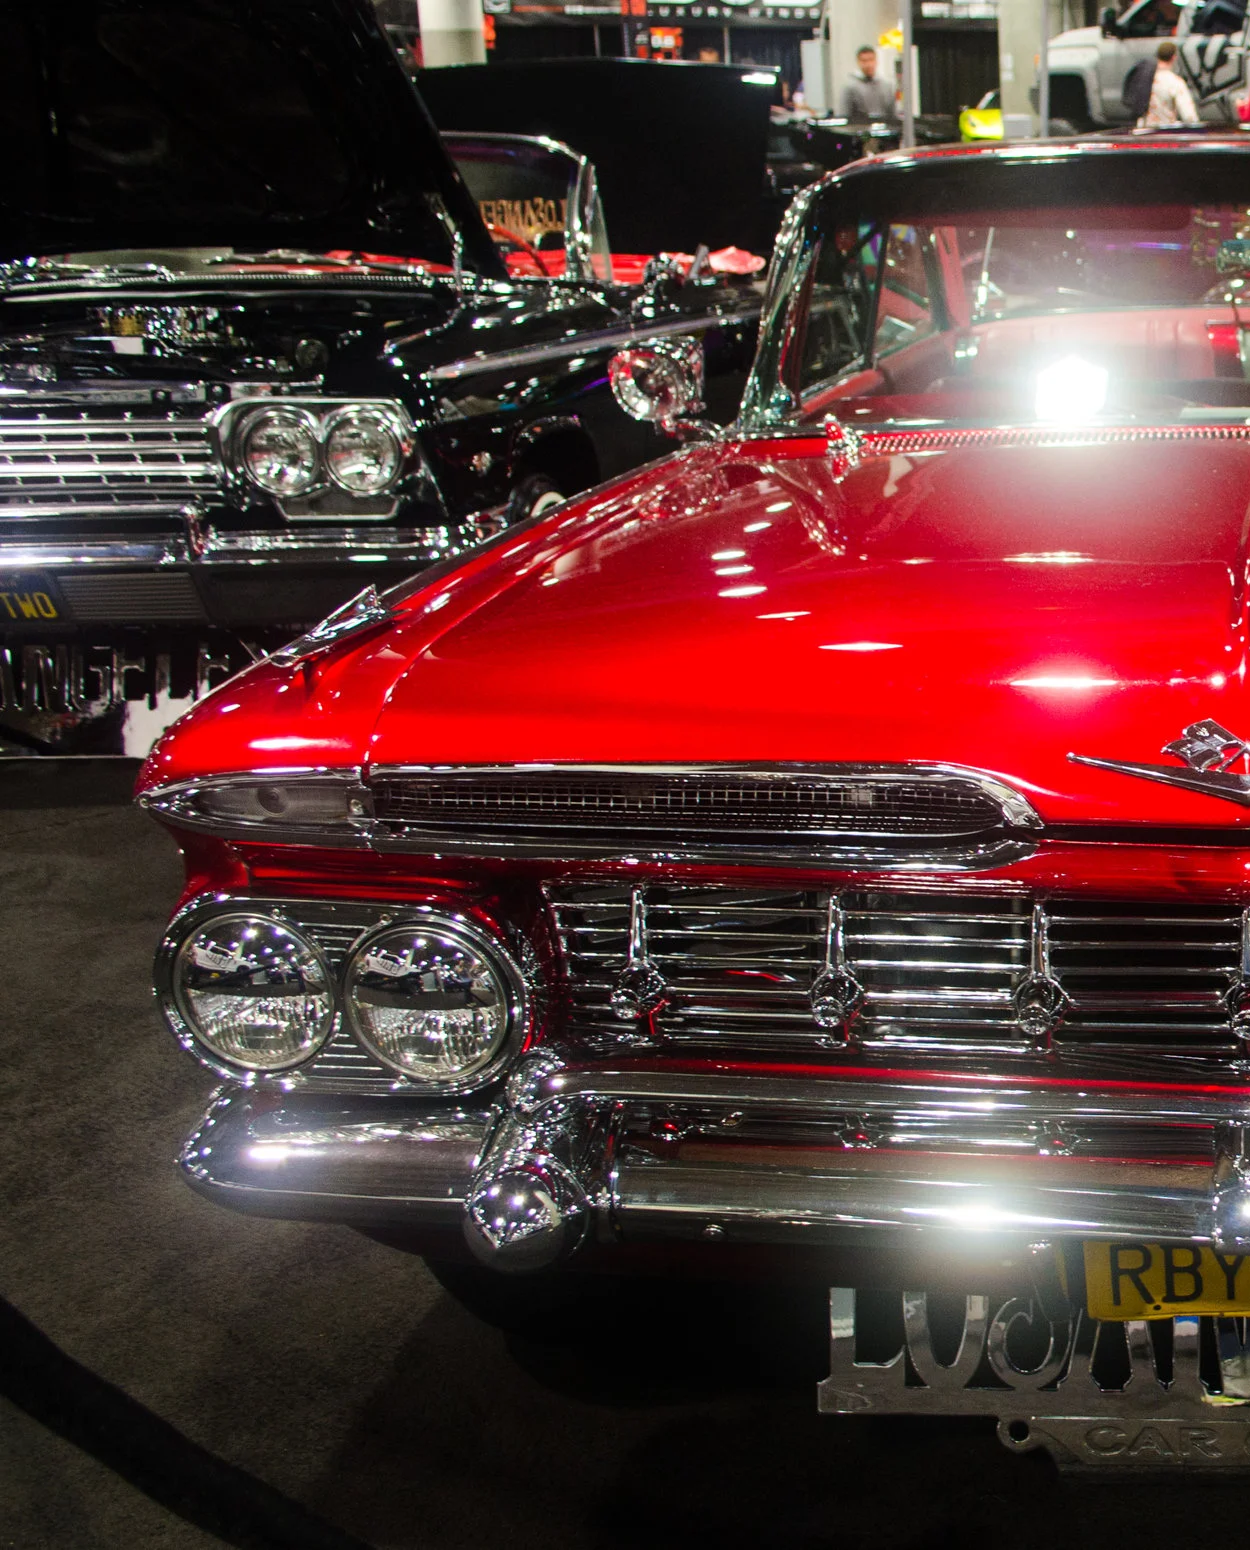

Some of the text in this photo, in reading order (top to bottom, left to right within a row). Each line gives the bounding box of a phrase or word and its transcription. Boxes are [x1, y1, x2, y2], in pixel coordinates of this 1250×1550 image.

[0, 591, 58, 619] TWO
[1109, 1243, 1245, 1306] RBY
[1083, 1425, 1223, 1458] CAR
